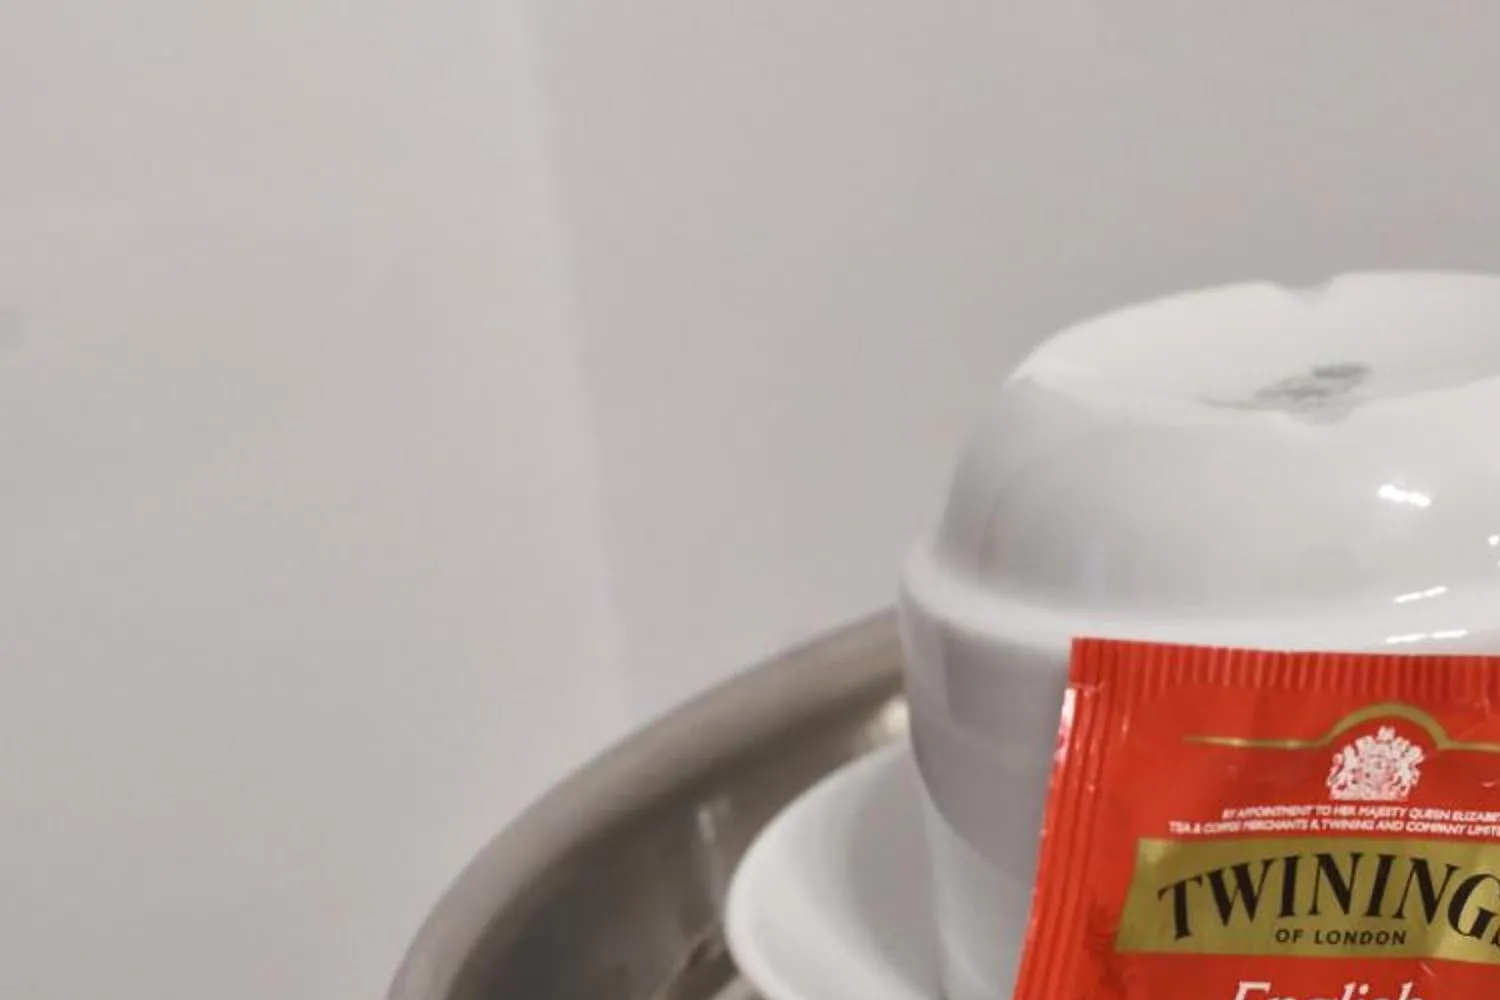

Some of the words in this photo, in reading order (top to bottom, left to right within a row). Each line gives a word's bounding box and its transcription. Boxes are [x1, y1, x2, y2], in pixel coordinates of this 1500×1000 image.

[1409, 808, 1450, 821] QUEEN
[1320, 819, 1374, 831] TWINING
[1375, 820, 1403, 831] AND
[1405, 821, 1468, 835] COMPANY
[1275, 929, 1304, 945] OF
[1314, 930, 1406, 946] LONDON
